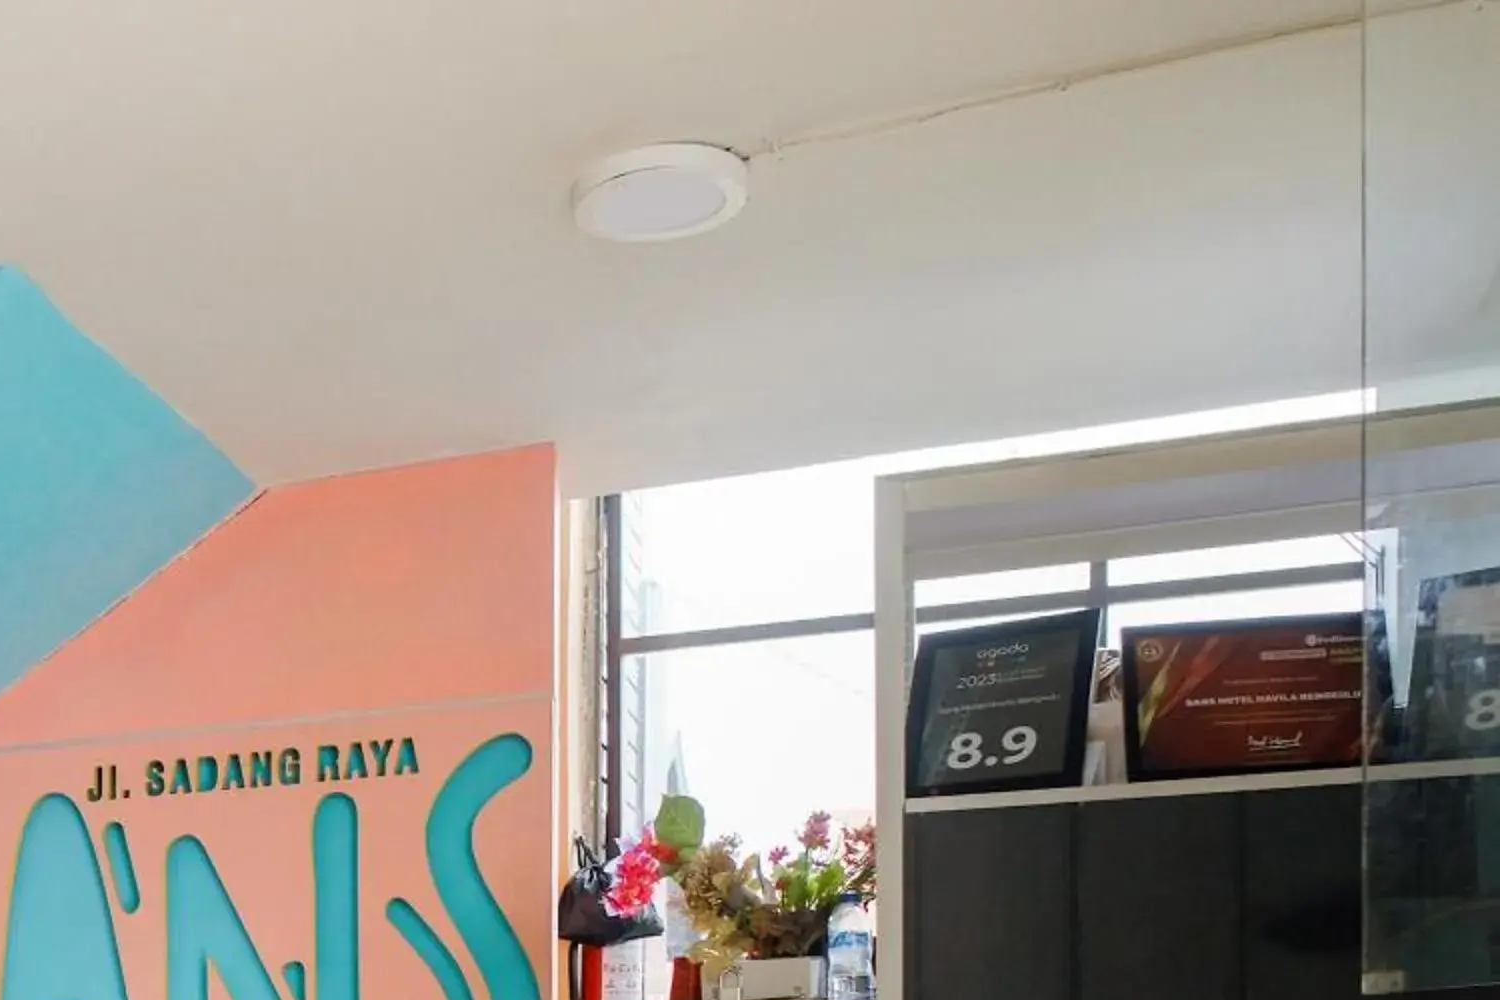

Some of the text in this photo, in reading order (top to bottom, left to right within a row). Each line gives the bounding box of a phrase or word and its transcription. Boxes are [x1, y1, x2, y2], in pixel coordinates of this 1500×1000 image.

[977, 643, 1029, 659] agoda
[145, 748, 301, 797] SADANG
[317, 737, 419, 782] RAYA
[947, 726, 1037, 769] 8.9
